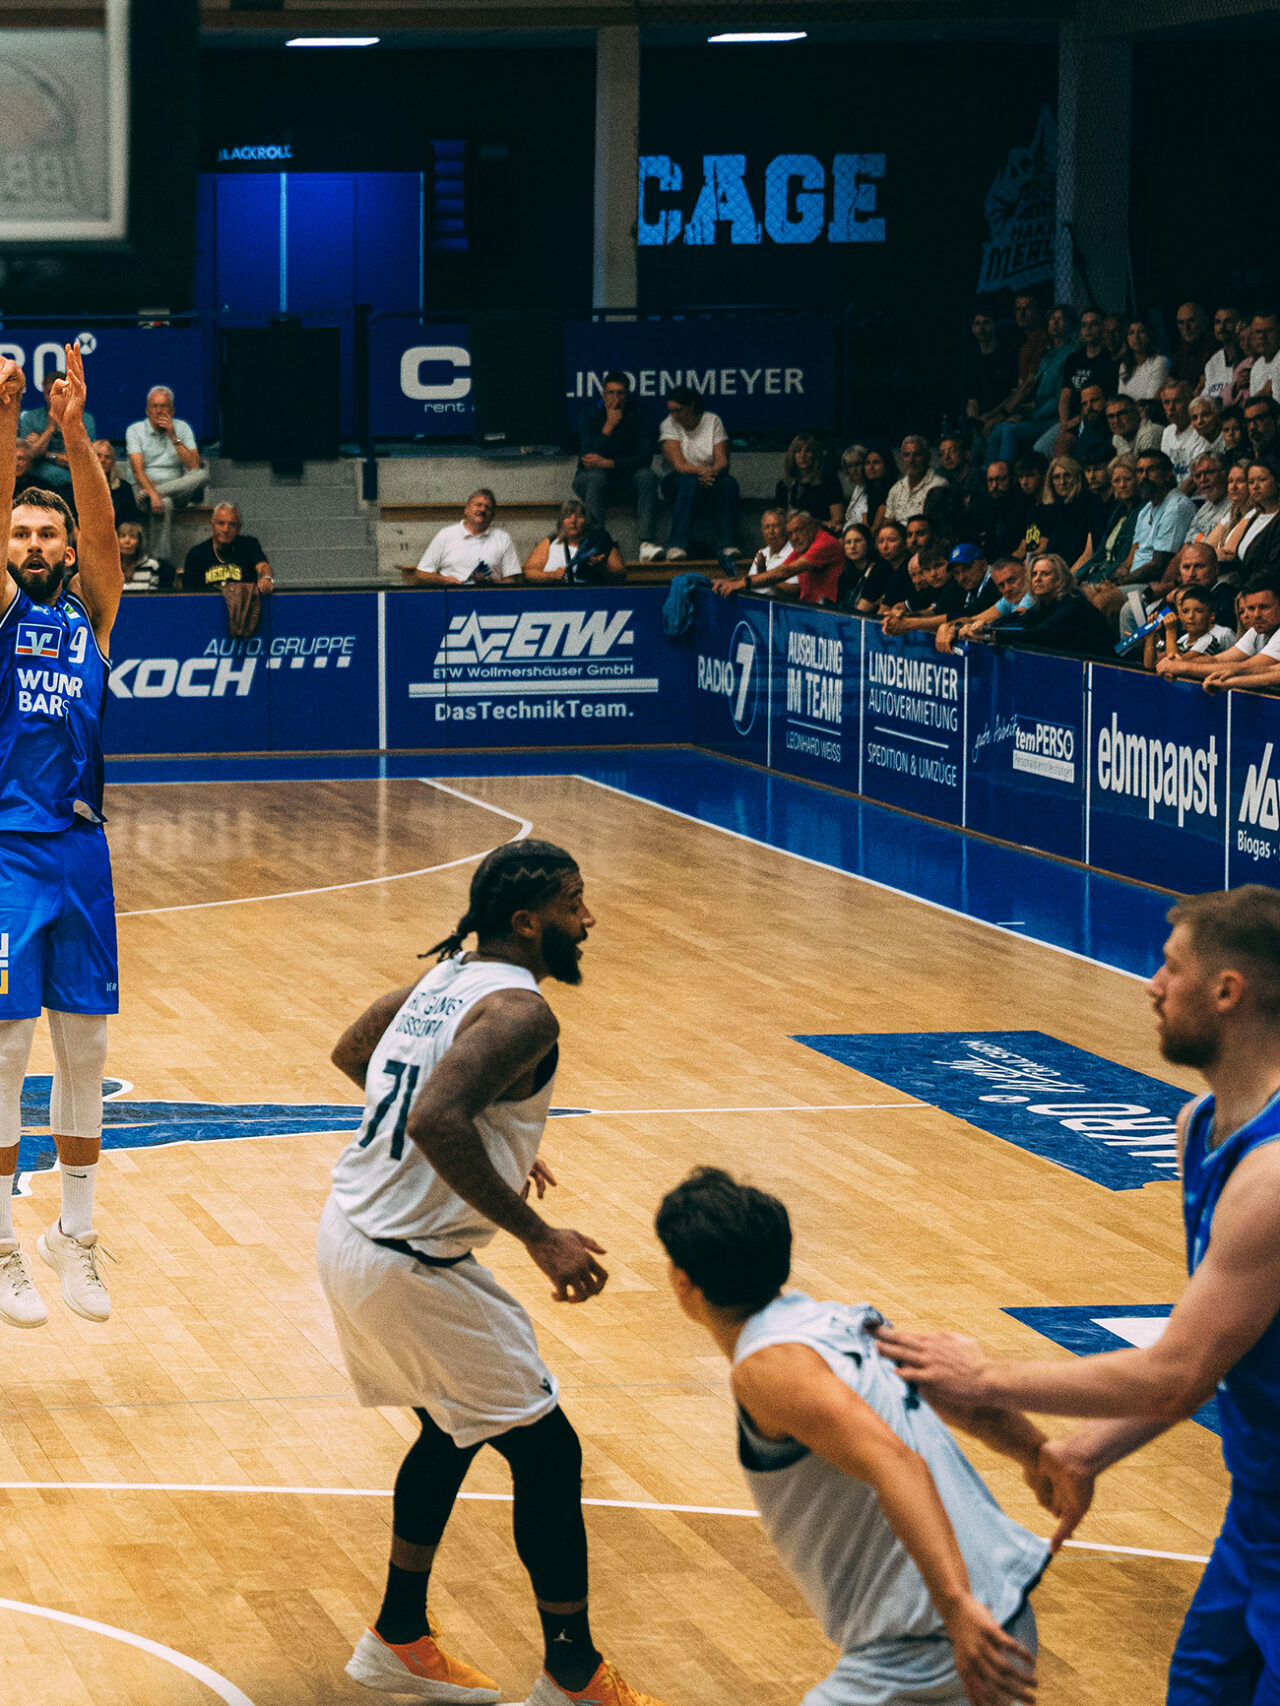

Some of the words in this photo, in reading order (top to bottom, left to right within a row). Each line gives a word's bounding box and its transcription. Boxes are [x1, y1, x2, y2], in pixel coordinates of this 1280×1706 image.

[638, 153, 886, 245] CAGE
[566, 368, 805, 398] INENMEYER
[424, 402, 465, 413] rent
[68, 626, 88, 664] 9
[270, 635, 357, 656] GRUPPE
[505, 609, 634, 658] ETW
[787, 630, 843, 676] AUSBILDUNG
[108, 656, 258, 699] KOCH
[433, 666, 463, 680] ETW
[467, 664, 583, 679] Wollmershäuser
[586, 662, 635, 677] GmbH
[697, 654, 735, 697] RADIO
[734, 642, 756, 723] 7
[786, 668, 802, 714] IM
[868, 650, 959, 702] LINDENMEYER
[868, 687, 959, 733] AUTOVERMIETUNG
[821, 738, 842, 764] WEISS
[1015, 722, 1074, 761] temPERSO
[867, 742, 909, 772] SPEDITION
[909, 759, 917, 777] &
[918, 756, 958, 788] UMZÜGE
[1097, 711, 1218, 828] ebmpapst
[1237, 829, 1271, 862] Biogas
[358, 1058, 421, 1161] 71
